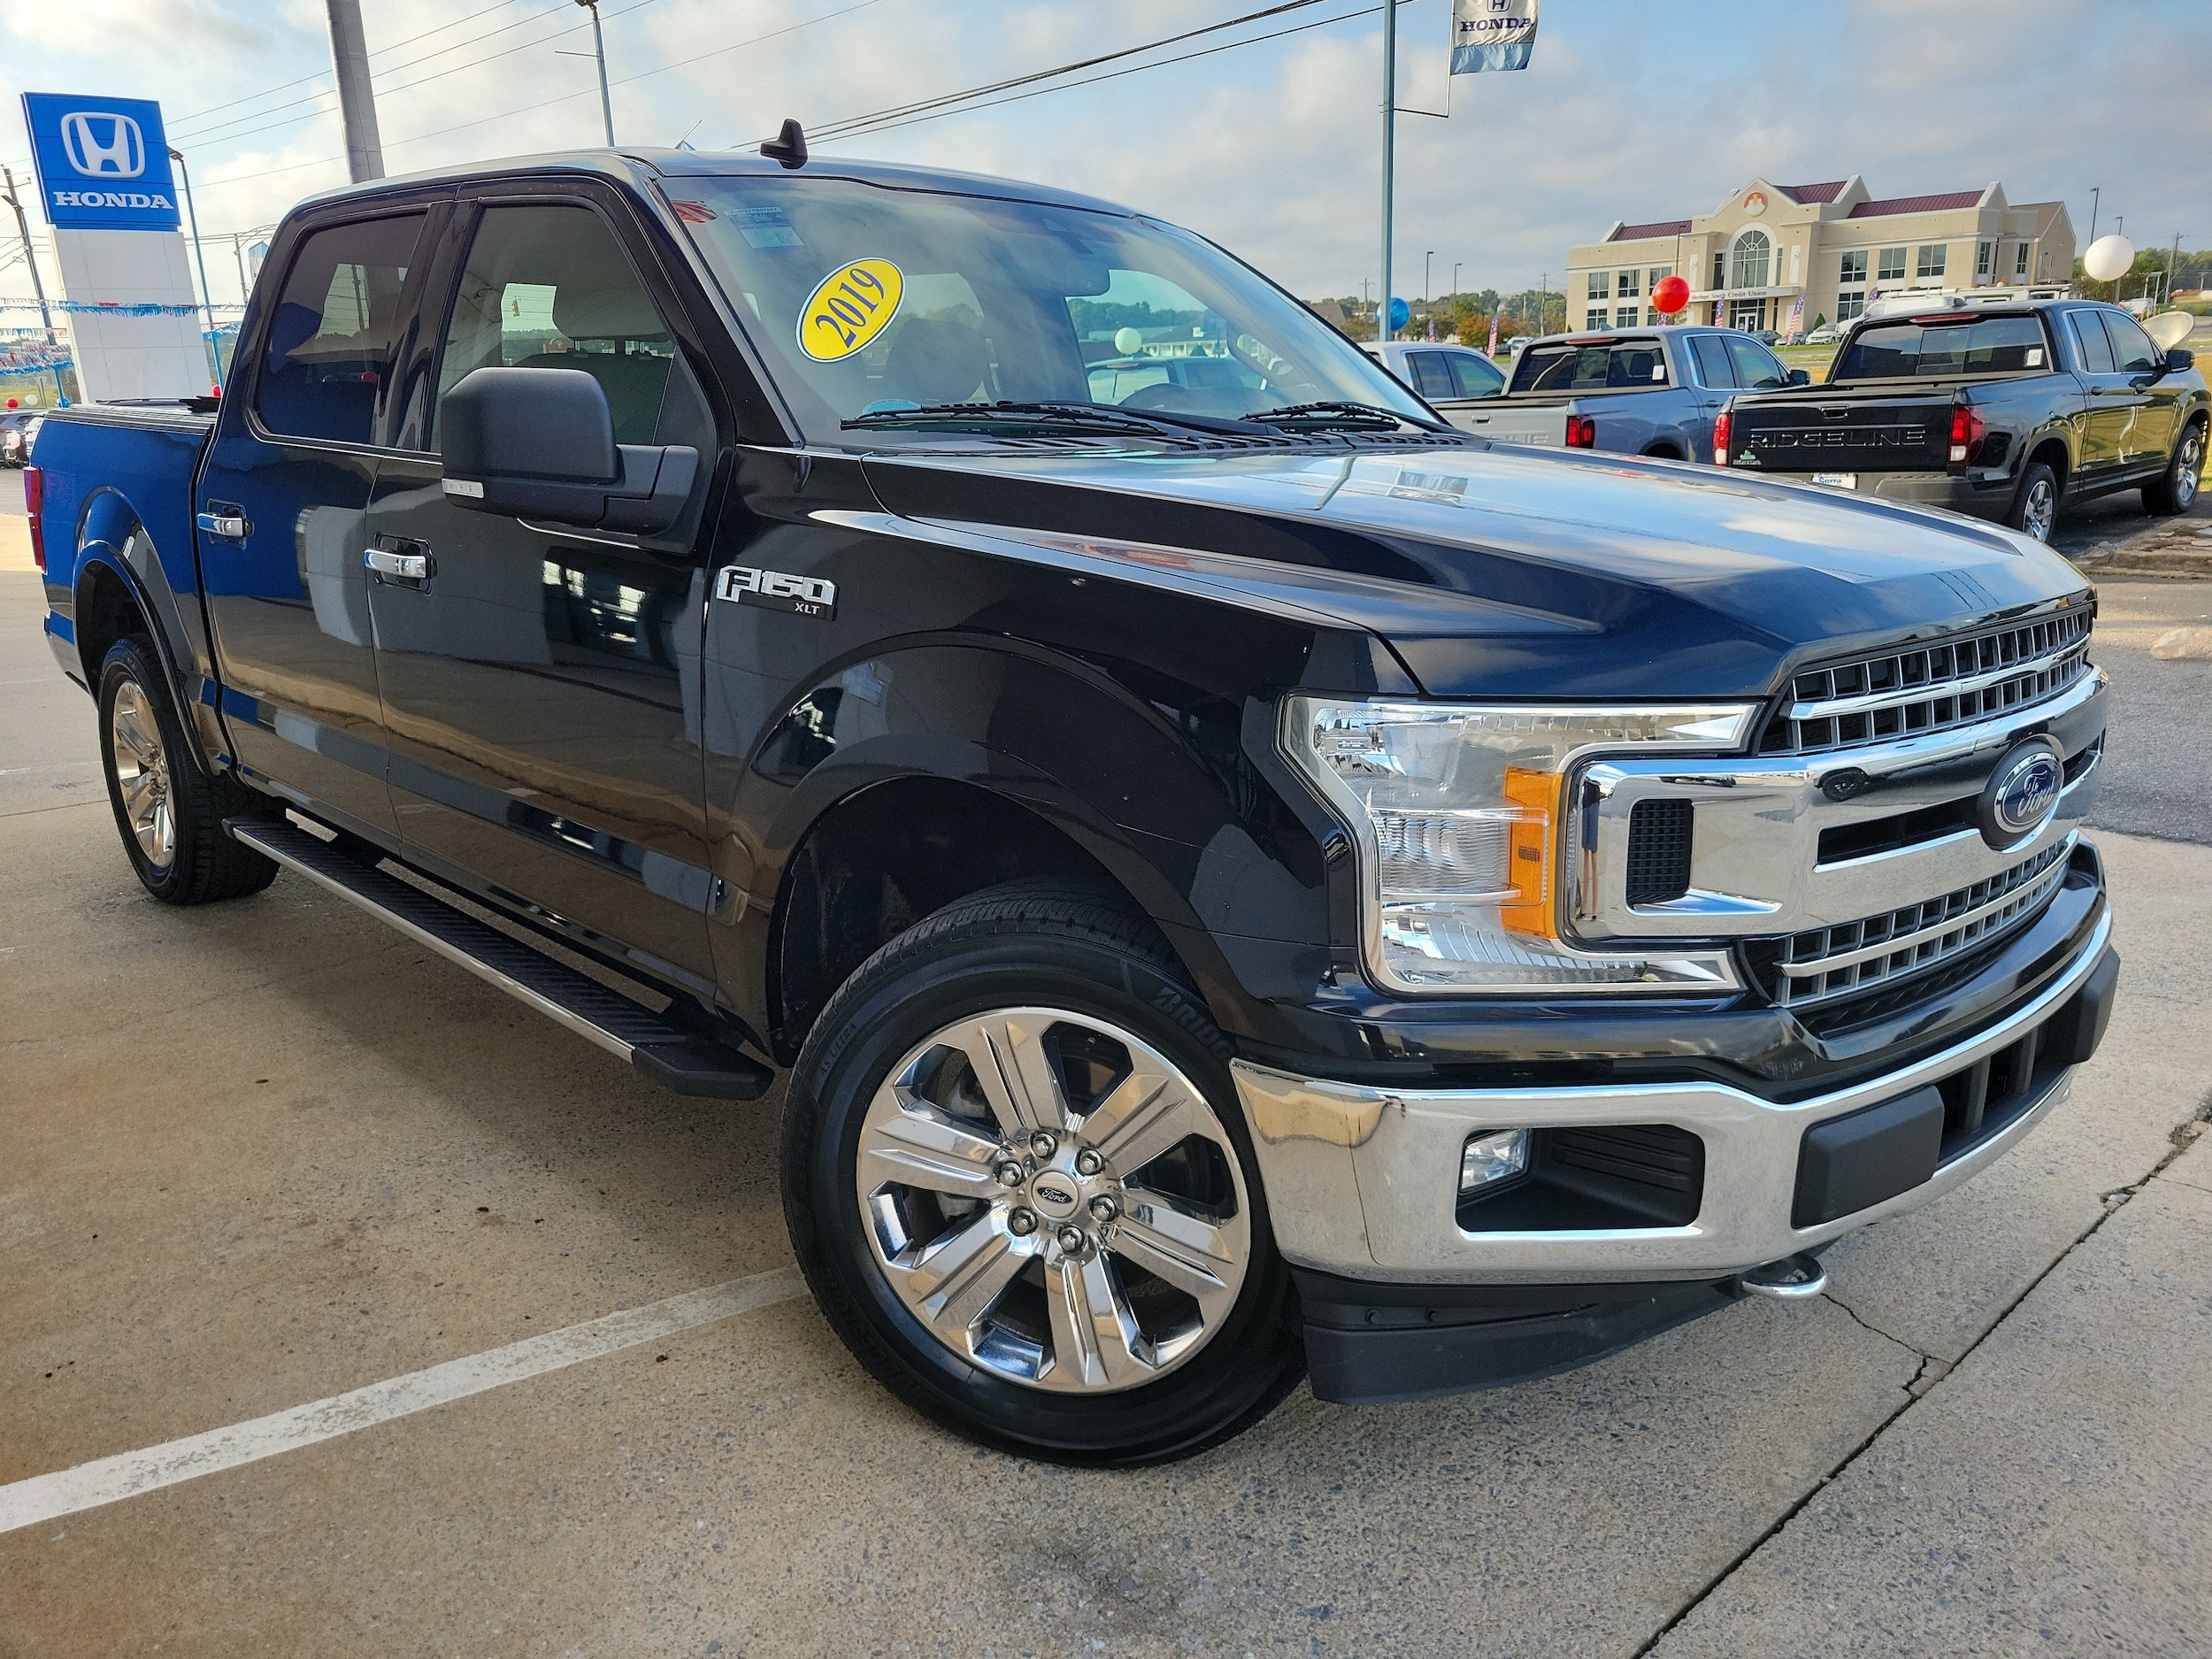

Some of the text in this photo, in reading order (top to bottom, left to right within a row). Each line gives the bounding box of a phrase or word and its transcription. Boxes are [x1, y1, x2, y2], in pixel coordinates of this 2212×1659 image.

[1460, 18, 1534, 32] HONDA
[53, 191, 174, 210] HONDA
[815, 268, 885, 349] 2019
[1747, 430, 1926, 449] RIDGELINE
[795, 602, 820, 615] XLT
[2016, 769, 2056, 818] Ford
[830, 1024, 857, 1057] ULTRA
[1041, 1187, 1067, 1202] Ford
